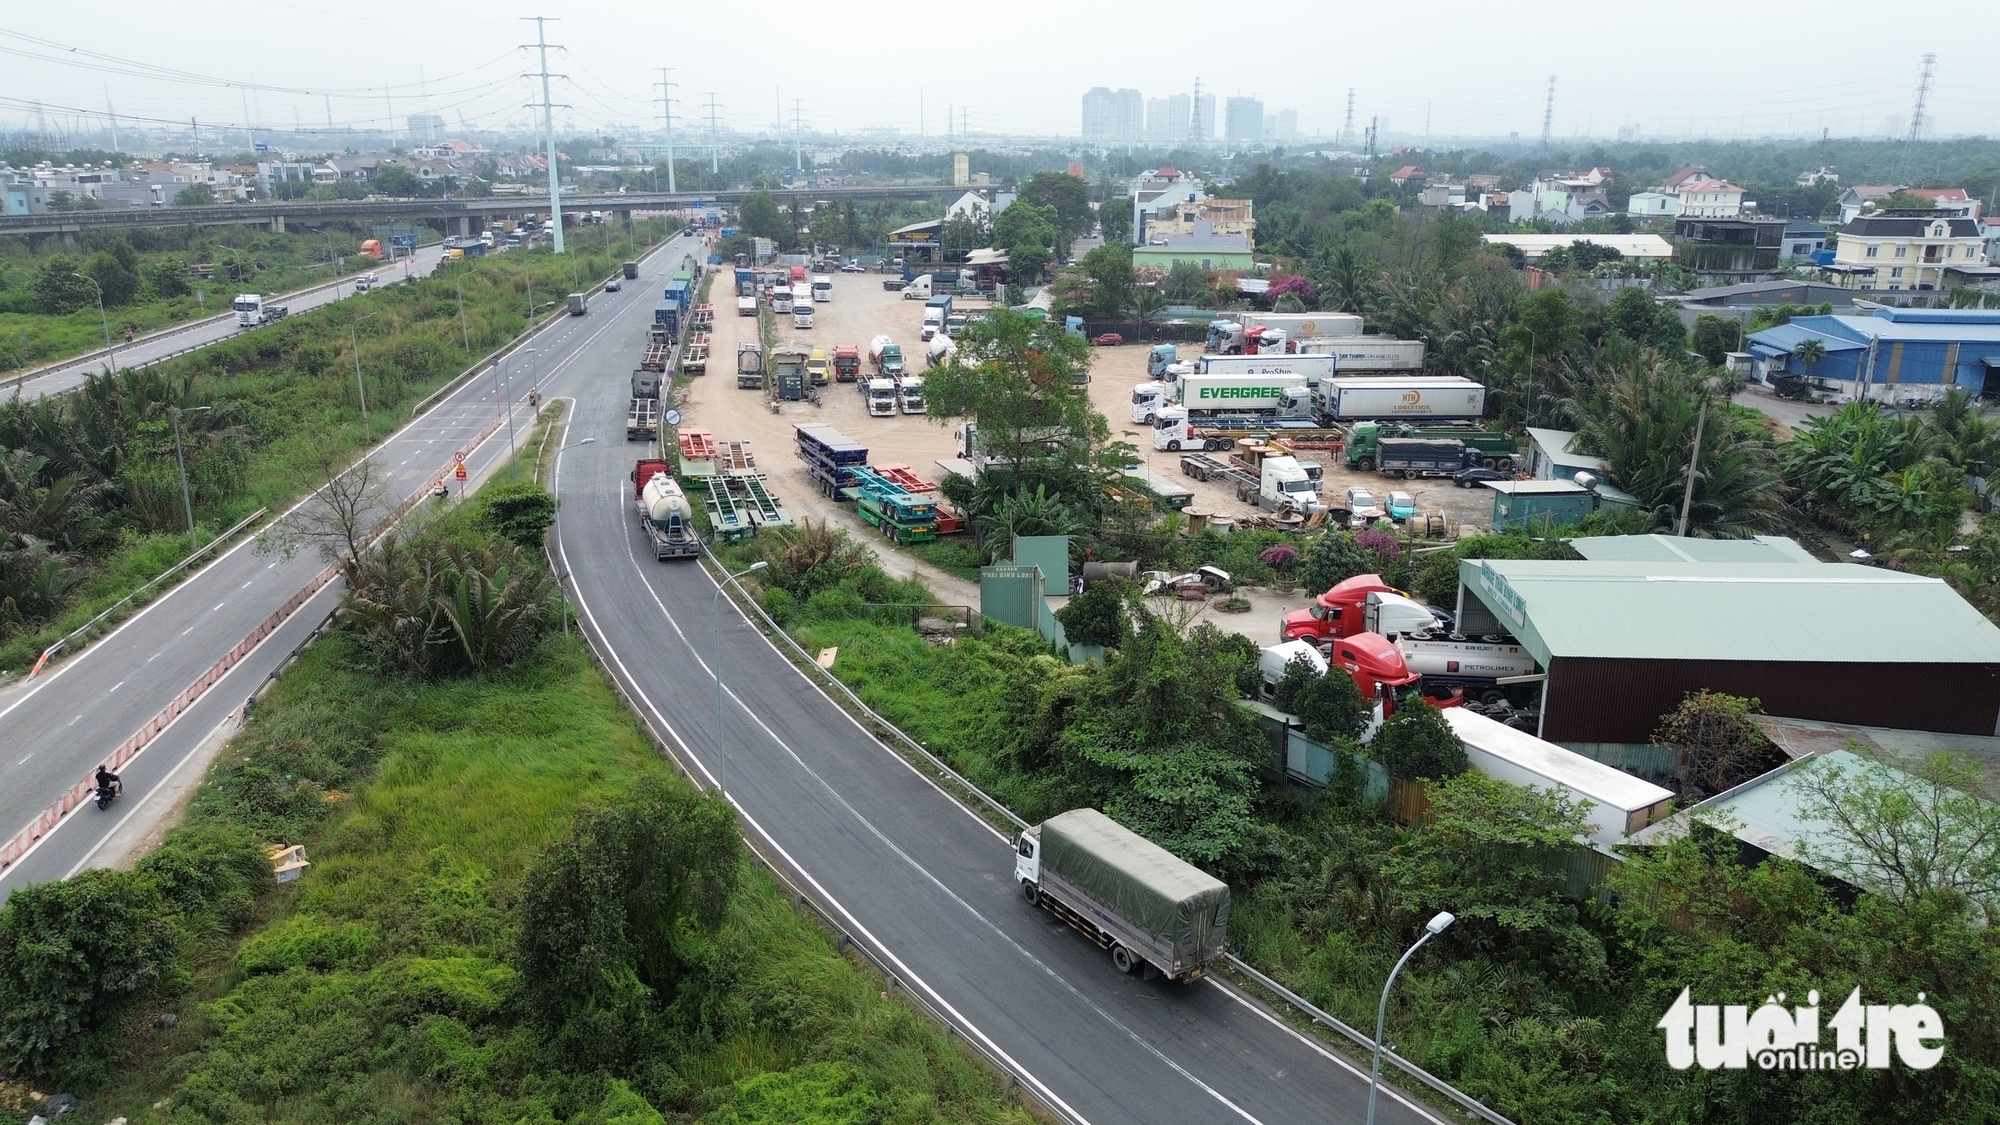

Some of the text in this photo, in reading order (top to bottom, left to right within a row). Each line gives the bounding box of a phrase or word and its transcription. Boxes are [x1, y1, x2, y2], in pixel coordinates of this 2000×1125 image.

[1200, 387, 1282, 399] EVERGREE
[1402, 393, 1416, 402] HTH
[1464, 664, 1515, 672] PETROLIMEX
